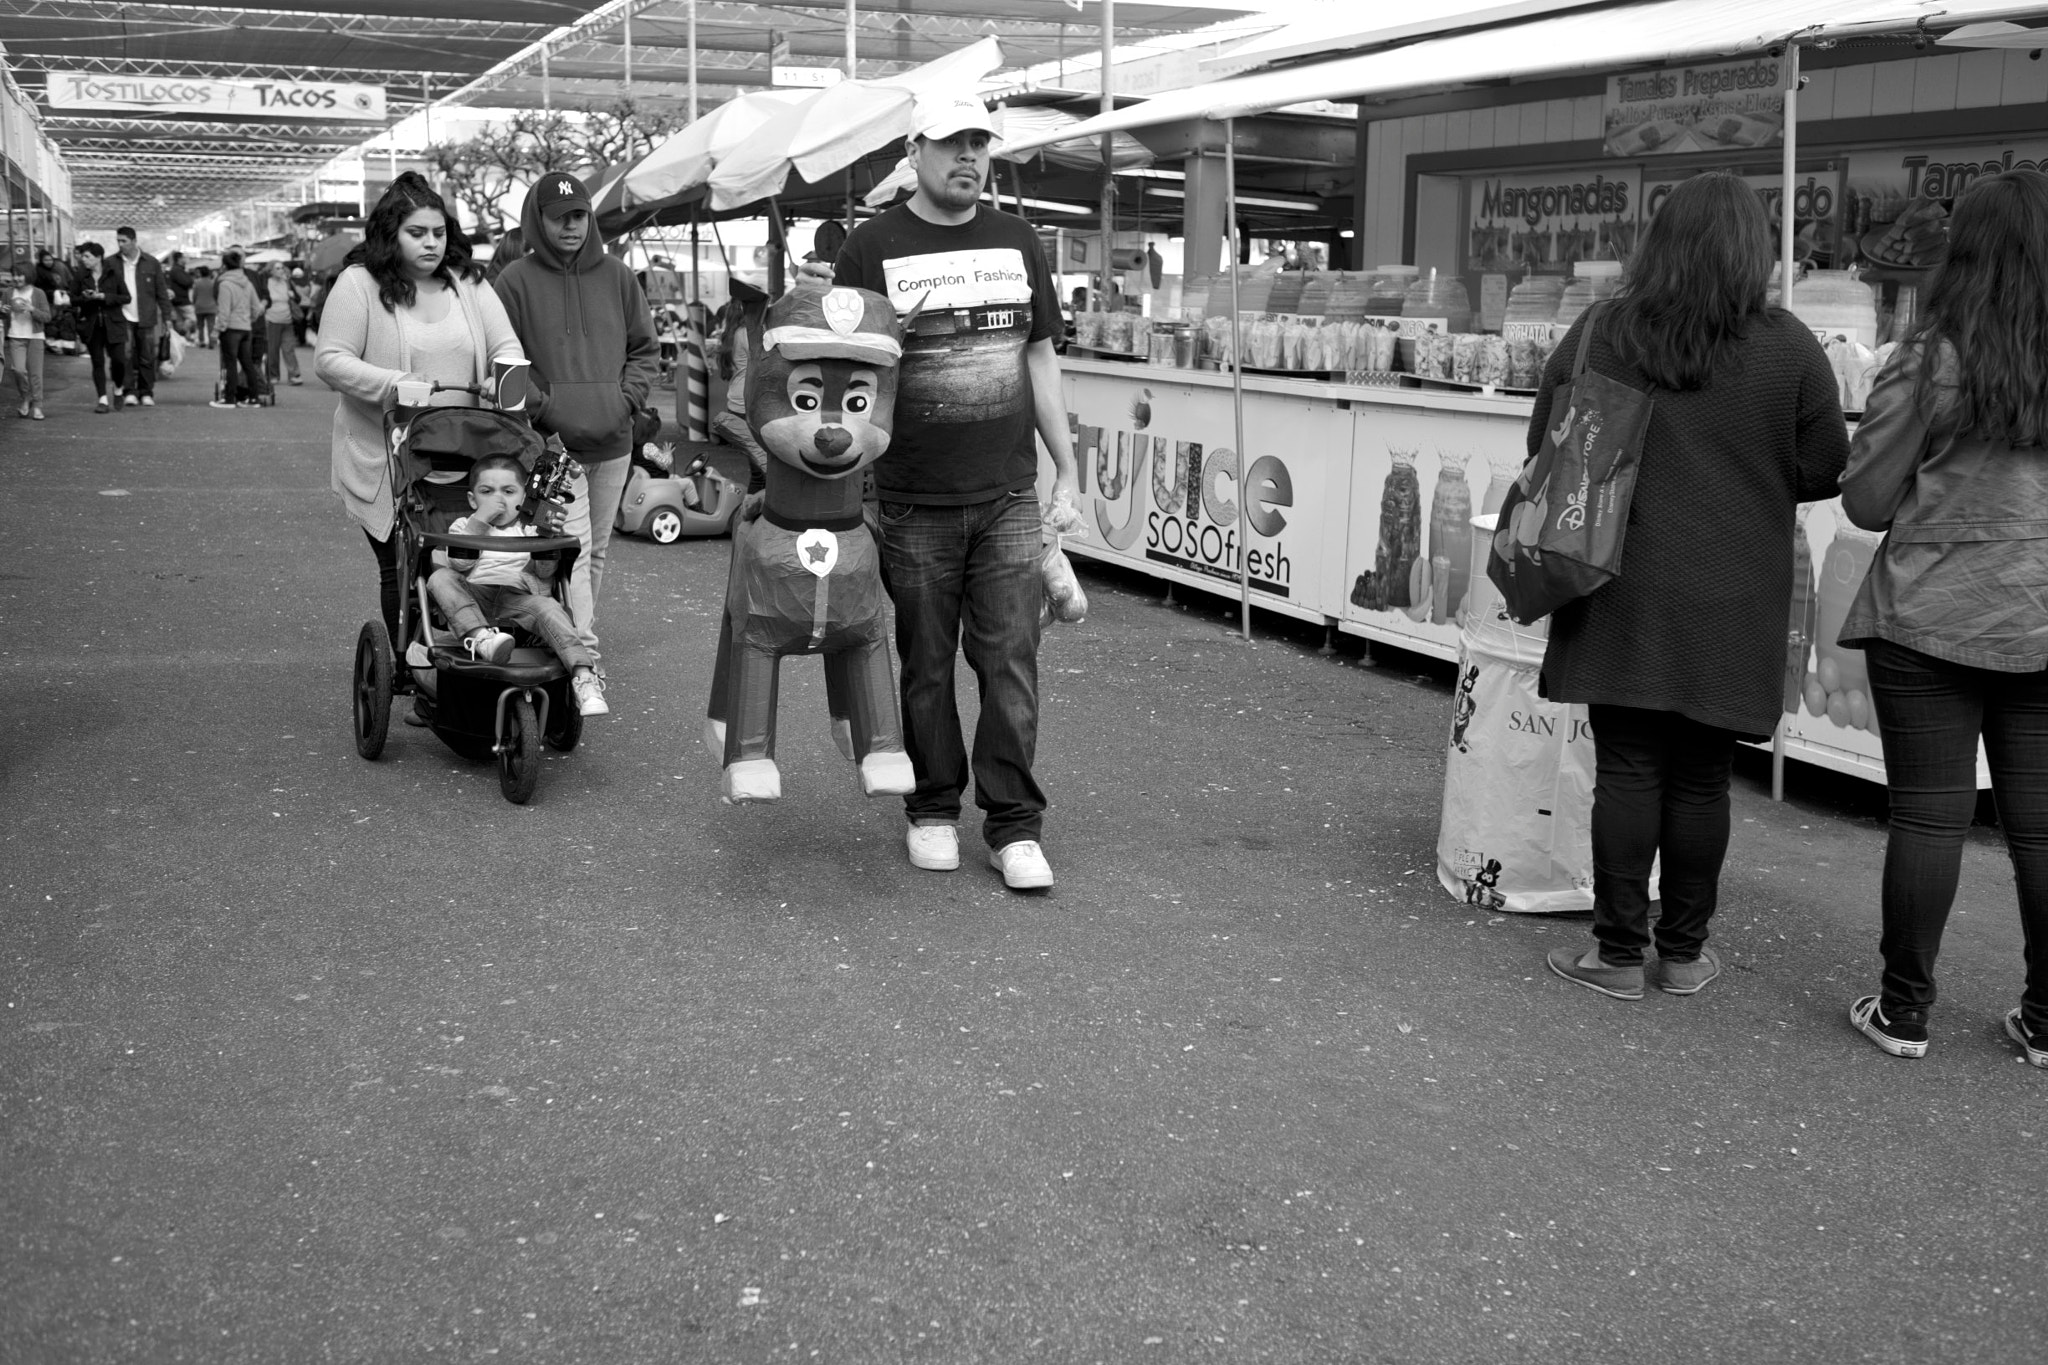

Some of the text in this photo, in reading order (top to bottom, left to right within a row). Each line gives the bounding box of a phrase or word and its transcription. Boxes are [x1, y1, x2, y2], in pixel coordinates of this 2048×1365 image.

[253, 83, 337, 109] TACOS
[1616, 60, 1780, 103] Tamales Preparados
[1480, 175, 1630, 227] Mangonadas
[897, 269, 1023, 292] Compton Fashion
[1066, 389, 1294, 551] rujuice
[1508, 710, 1558, 737] SAN
